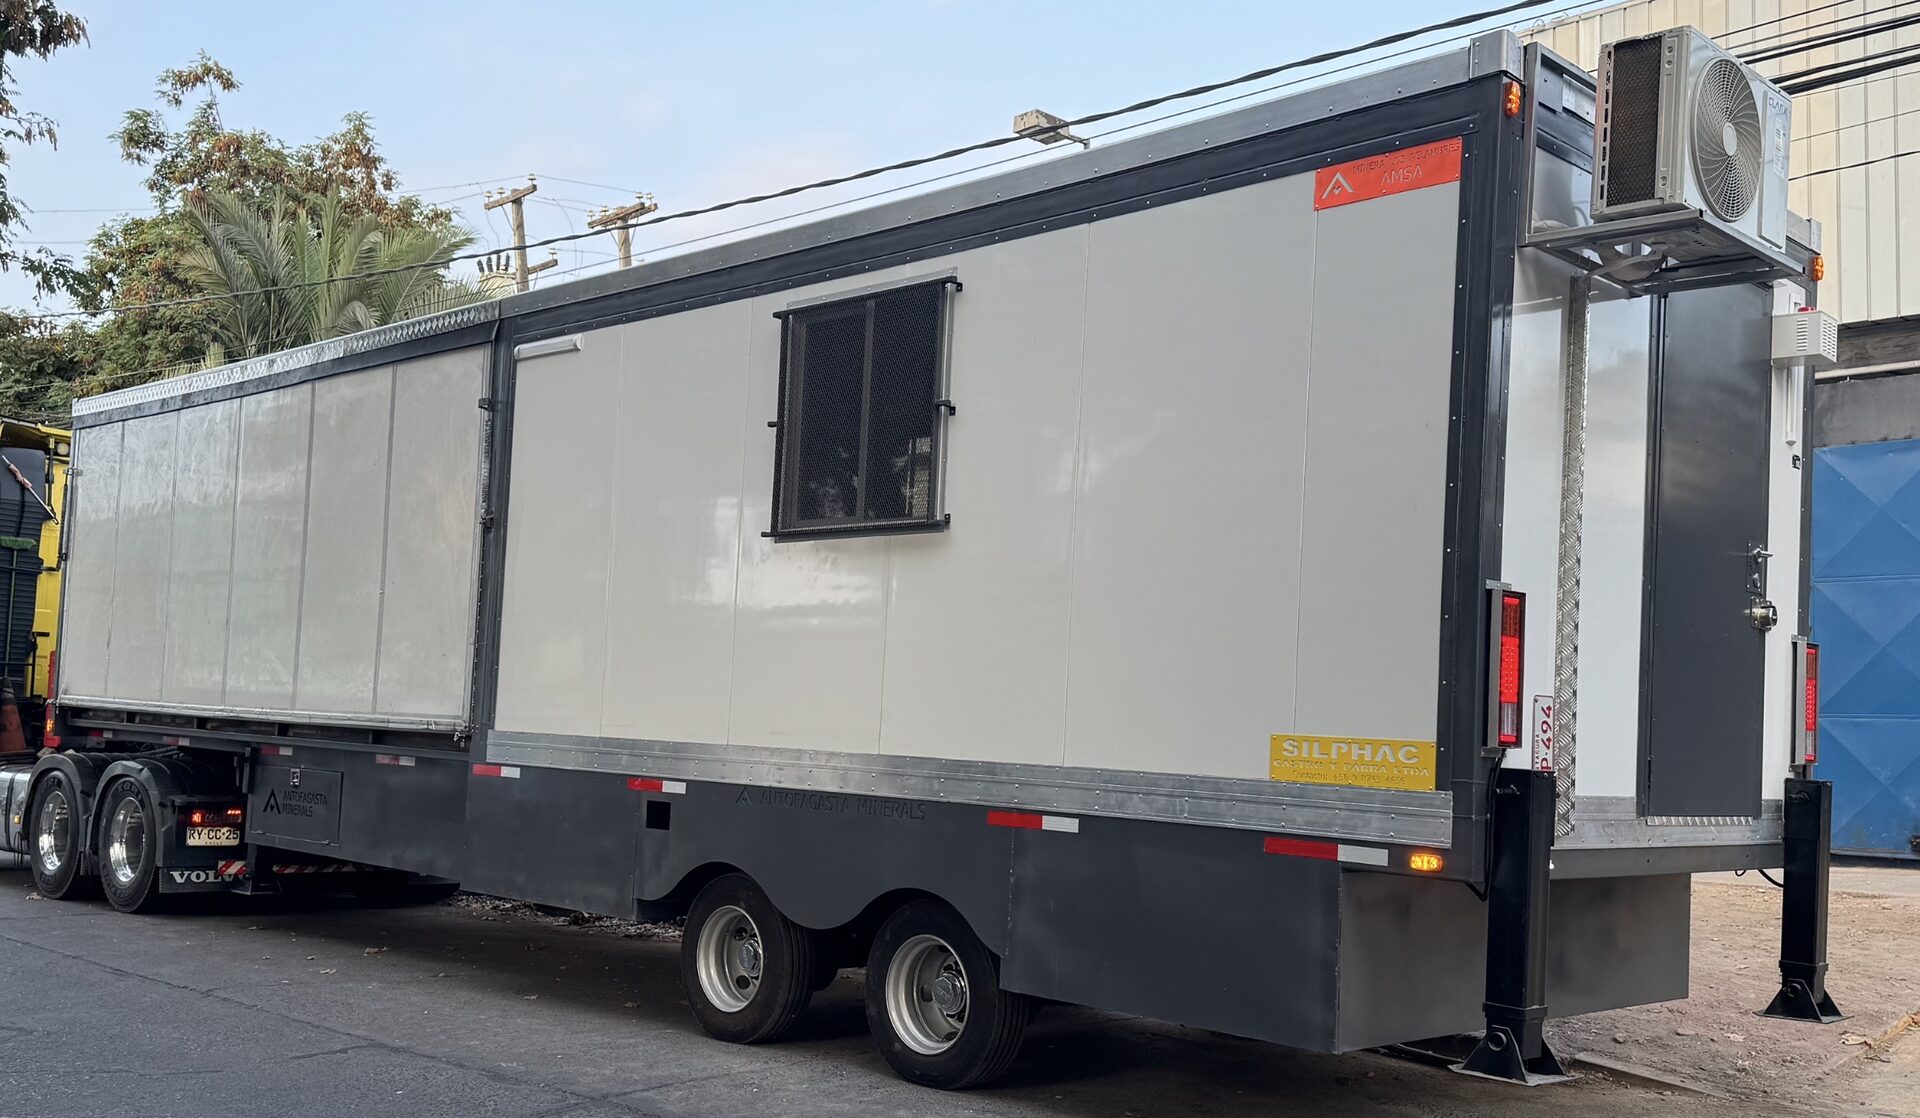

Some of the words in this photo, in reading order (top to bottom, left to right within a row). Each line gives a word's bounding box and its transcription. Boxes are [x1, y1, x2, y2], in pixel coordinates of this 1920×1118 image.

[1353, 159, 1384, 173] MINERA
[1381, 164, 1423, 185] AMSA
[1282, 738, 1420, 764] SILPHAC
[1330, 762, 1337, 771] Y
[1343, 762, 1387, 775] PARRA
[283, 790, 328, 806] ANTOFAGASTA
[760, 790, 849, 813] ANTOFAGASTA
[856, 797, 926, 821] MINERALS
[282, 803, 313, 817] MINERALS
[170, 870, 243, 884] VOLV
